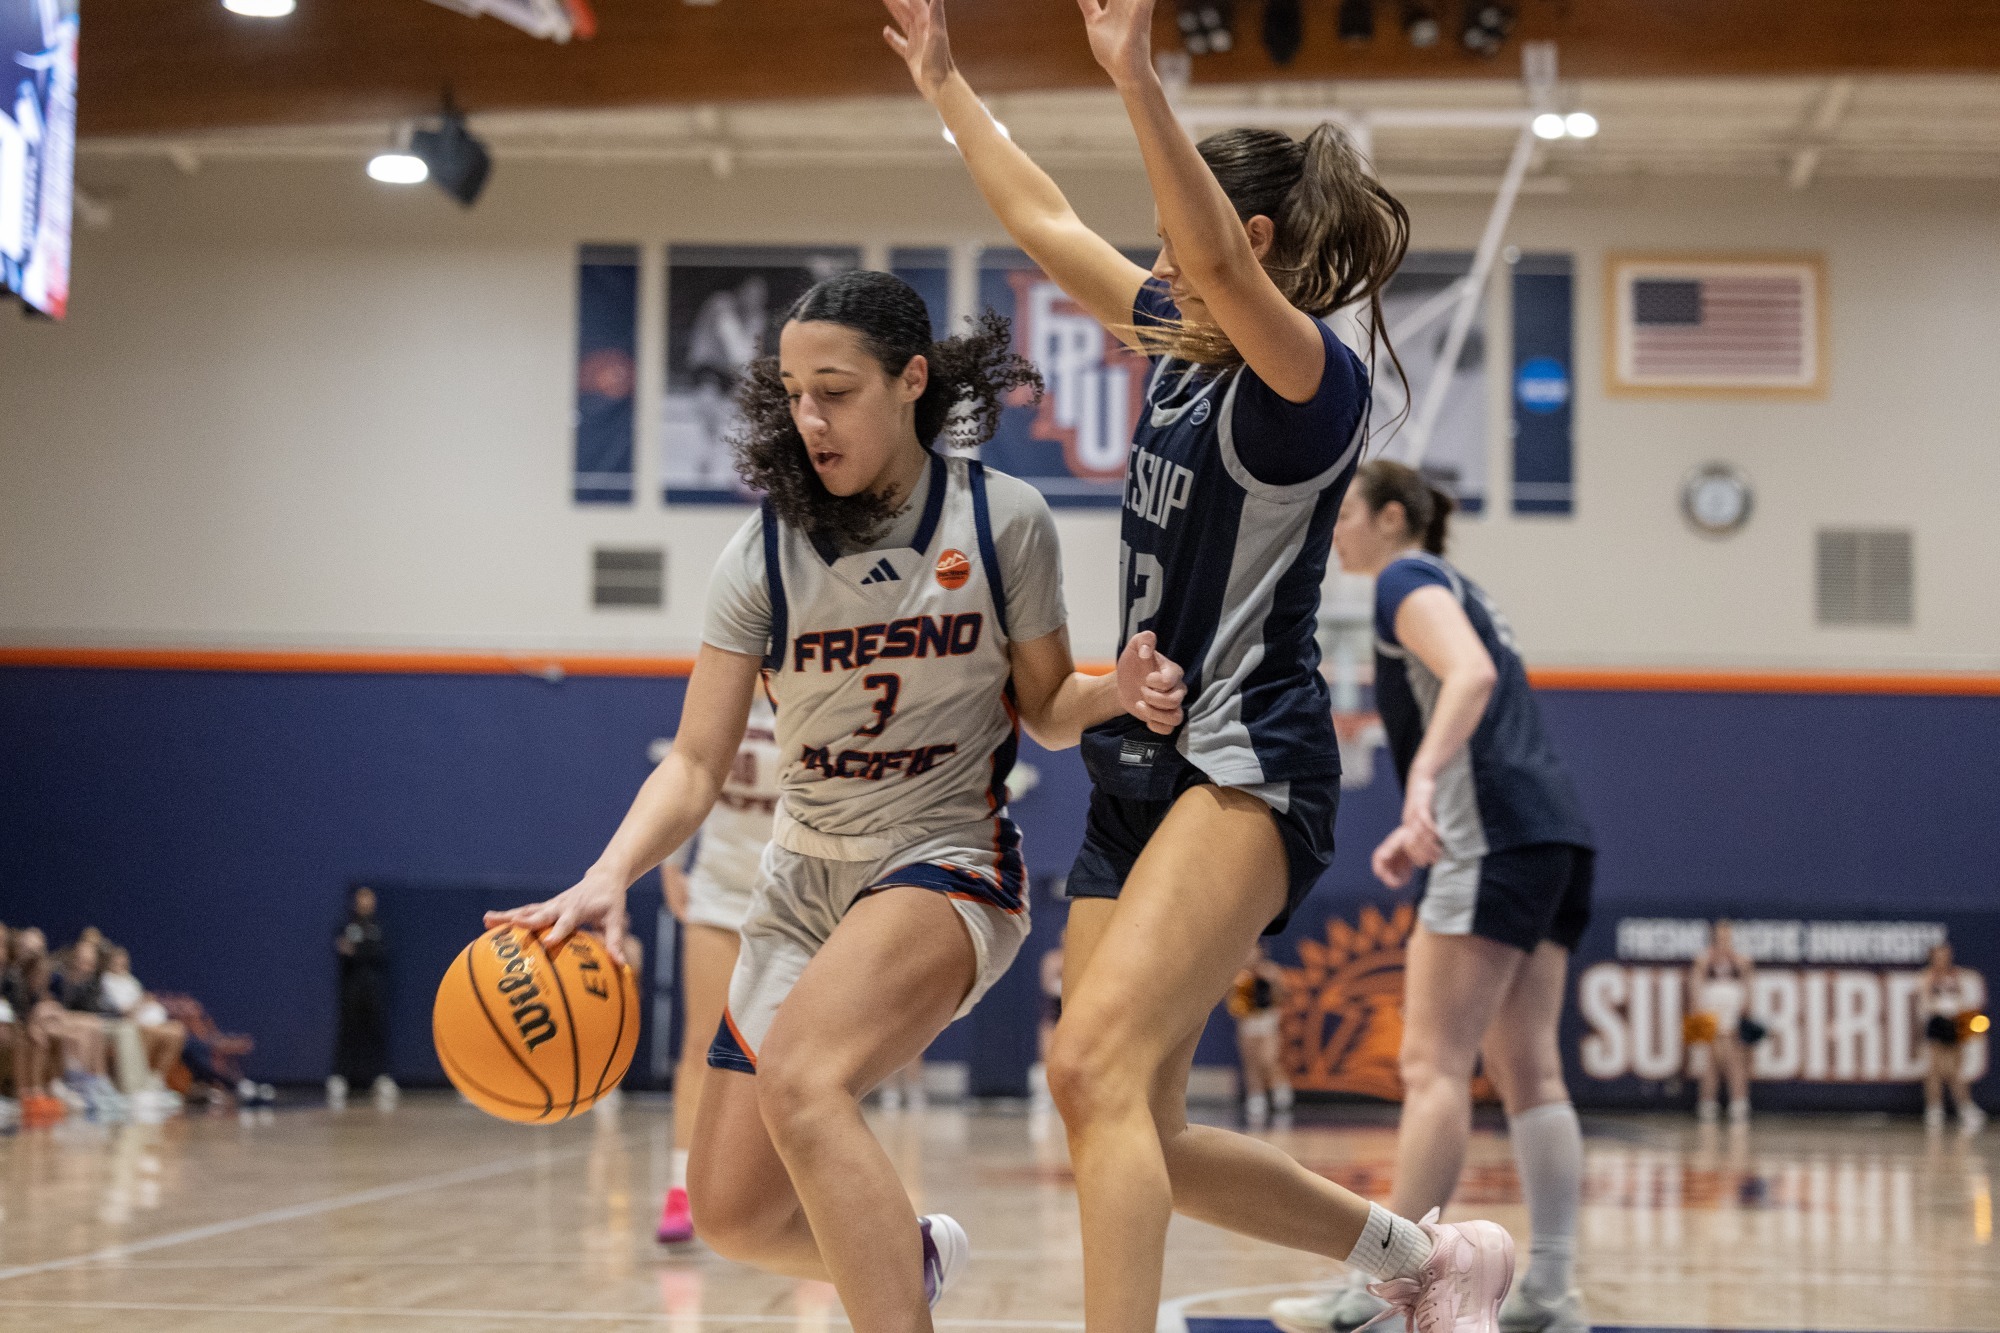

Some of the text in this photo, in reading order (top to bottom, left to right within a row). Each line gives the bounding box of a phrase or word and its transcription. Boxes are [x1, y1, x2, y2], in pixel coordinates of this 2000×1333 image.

[793, 612, 983, 672] FRESNO
[853, 673, 901, 737] 3
[491, 926, 558, 1053] Wilson
